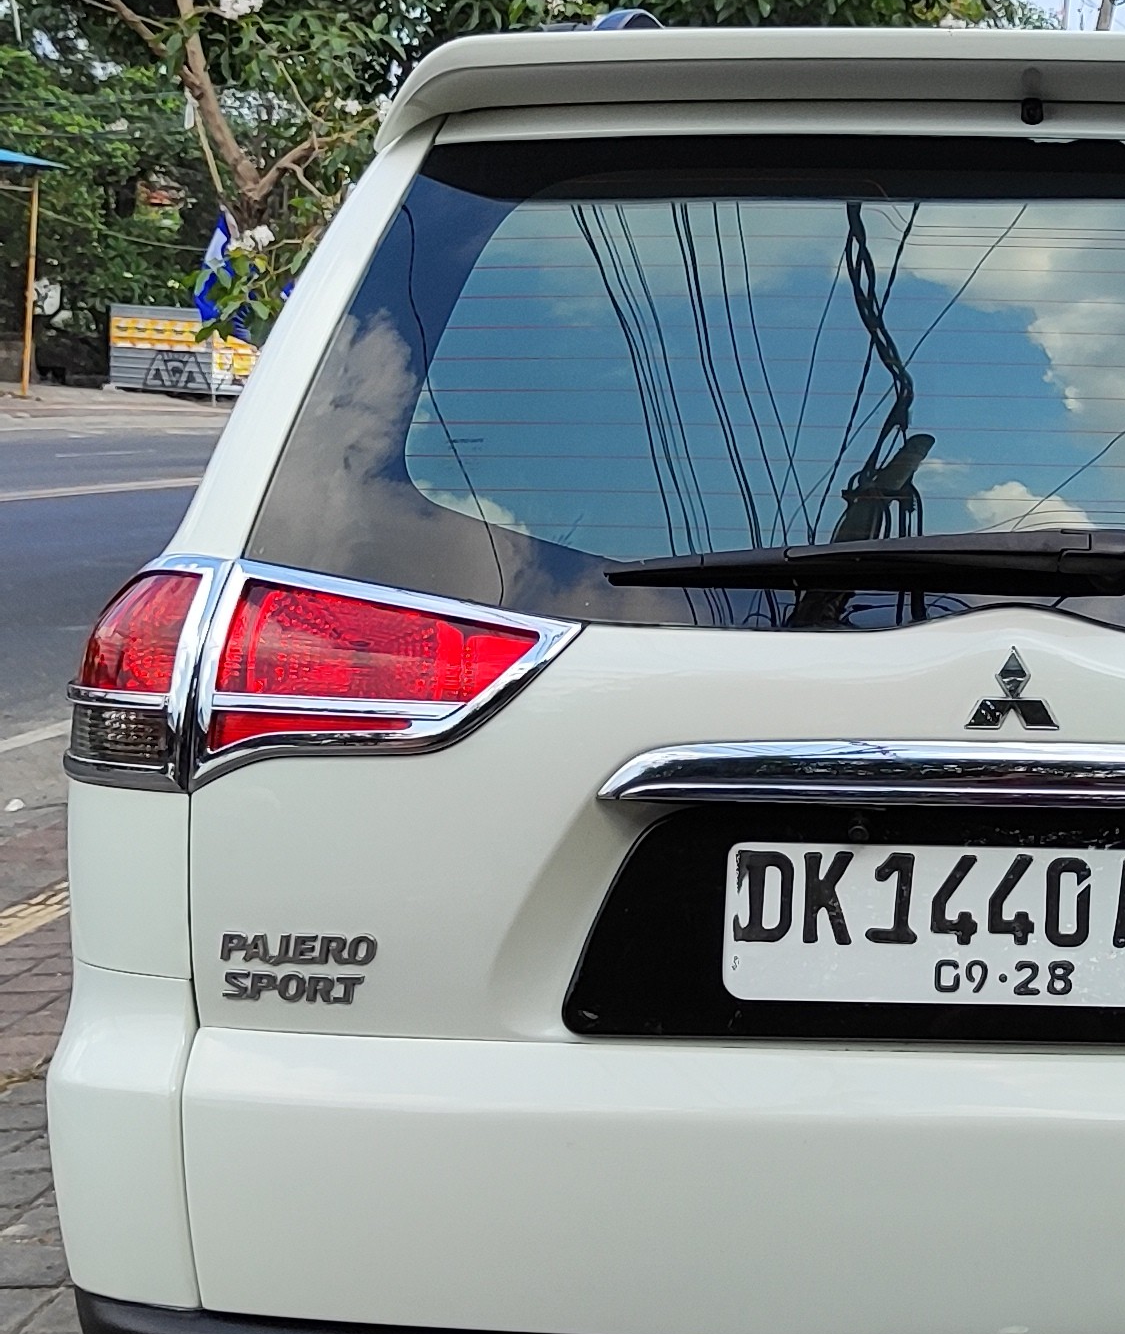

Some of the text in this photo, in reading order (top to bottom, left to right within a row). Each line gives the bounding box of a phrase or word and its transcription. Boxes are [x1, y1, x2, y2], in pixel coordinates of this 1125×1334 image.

[732, 849, 854, 946] DK
[864, 851, 1092, 948] 1440
[219, 930, 378, 966] PAJERO
[221, 968, 366, 1005] SPORT
